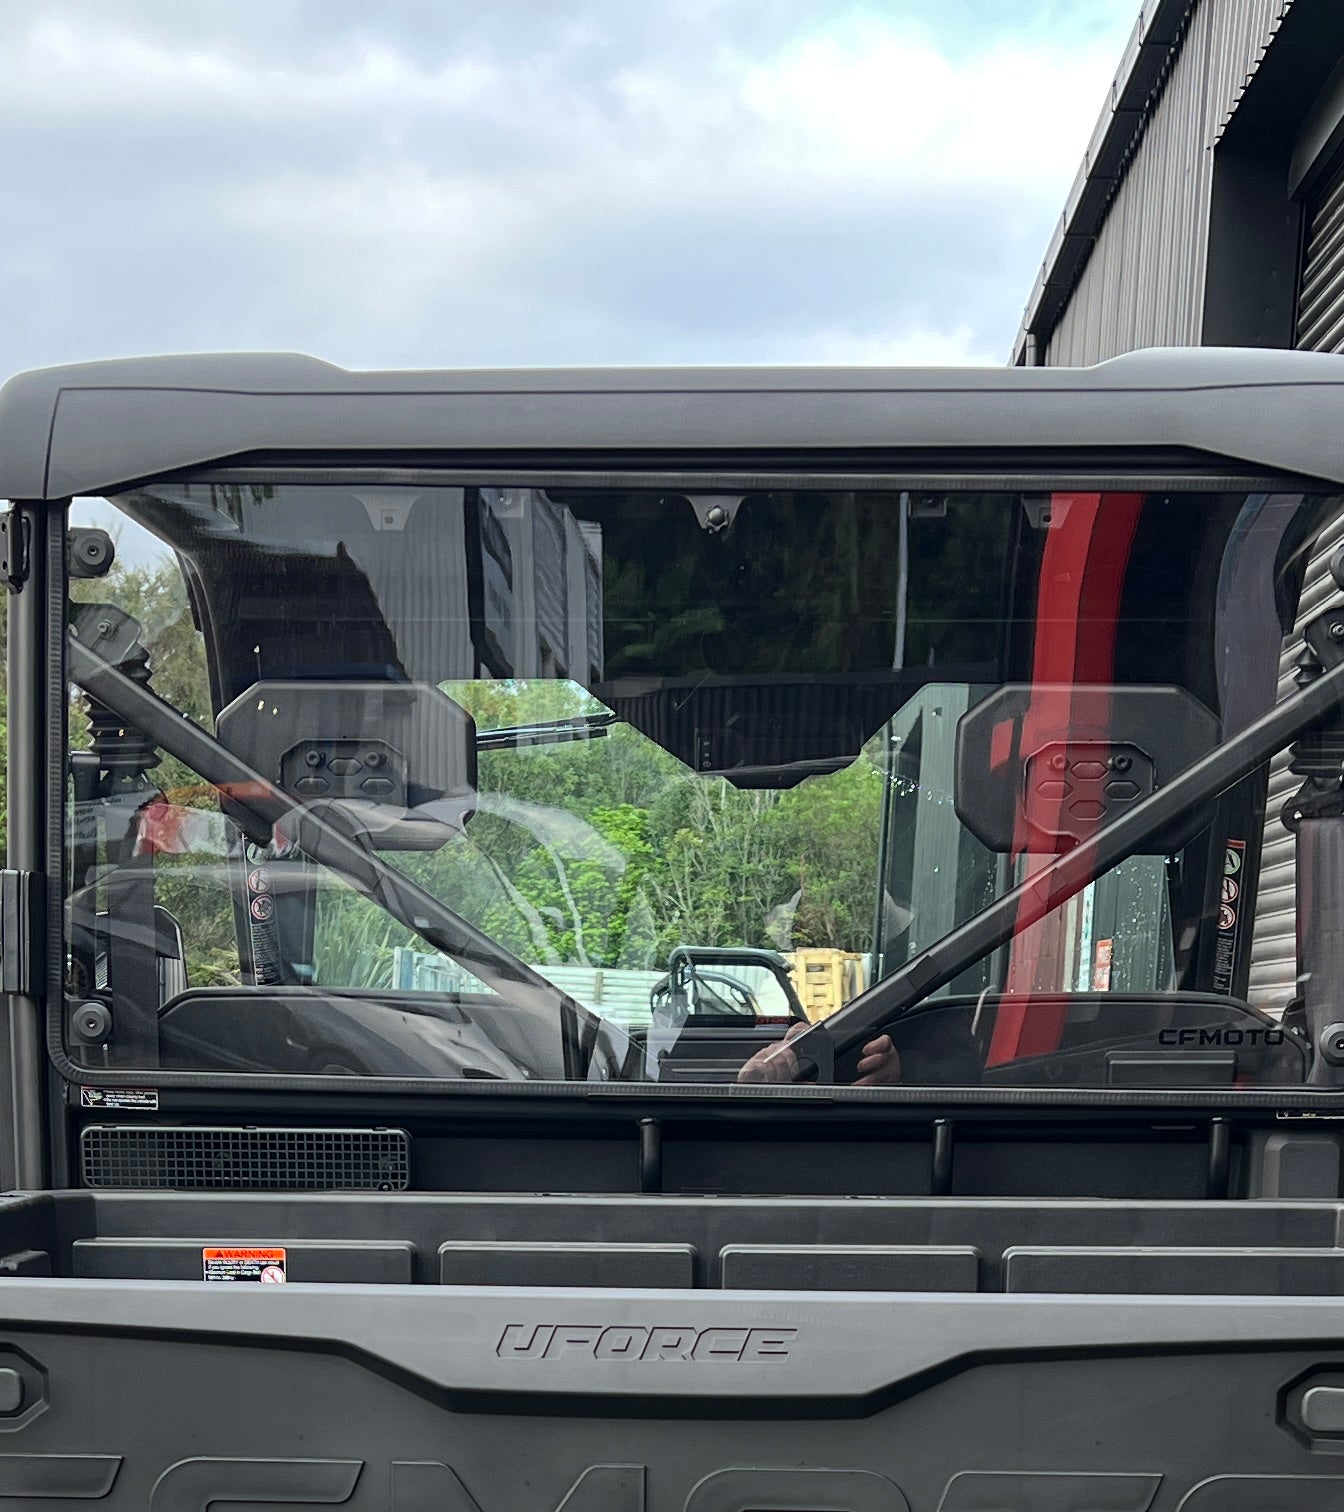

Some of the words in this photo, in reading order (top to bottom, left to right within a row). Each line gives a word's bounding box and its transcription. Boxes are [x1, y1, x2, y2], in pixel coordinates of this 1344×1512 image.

[1158, 1029, 1285, 1046] CFMOTO
[223, 1249, 274, 1258] WARNING
[495, 1324, 799, 1363] UFORCE
